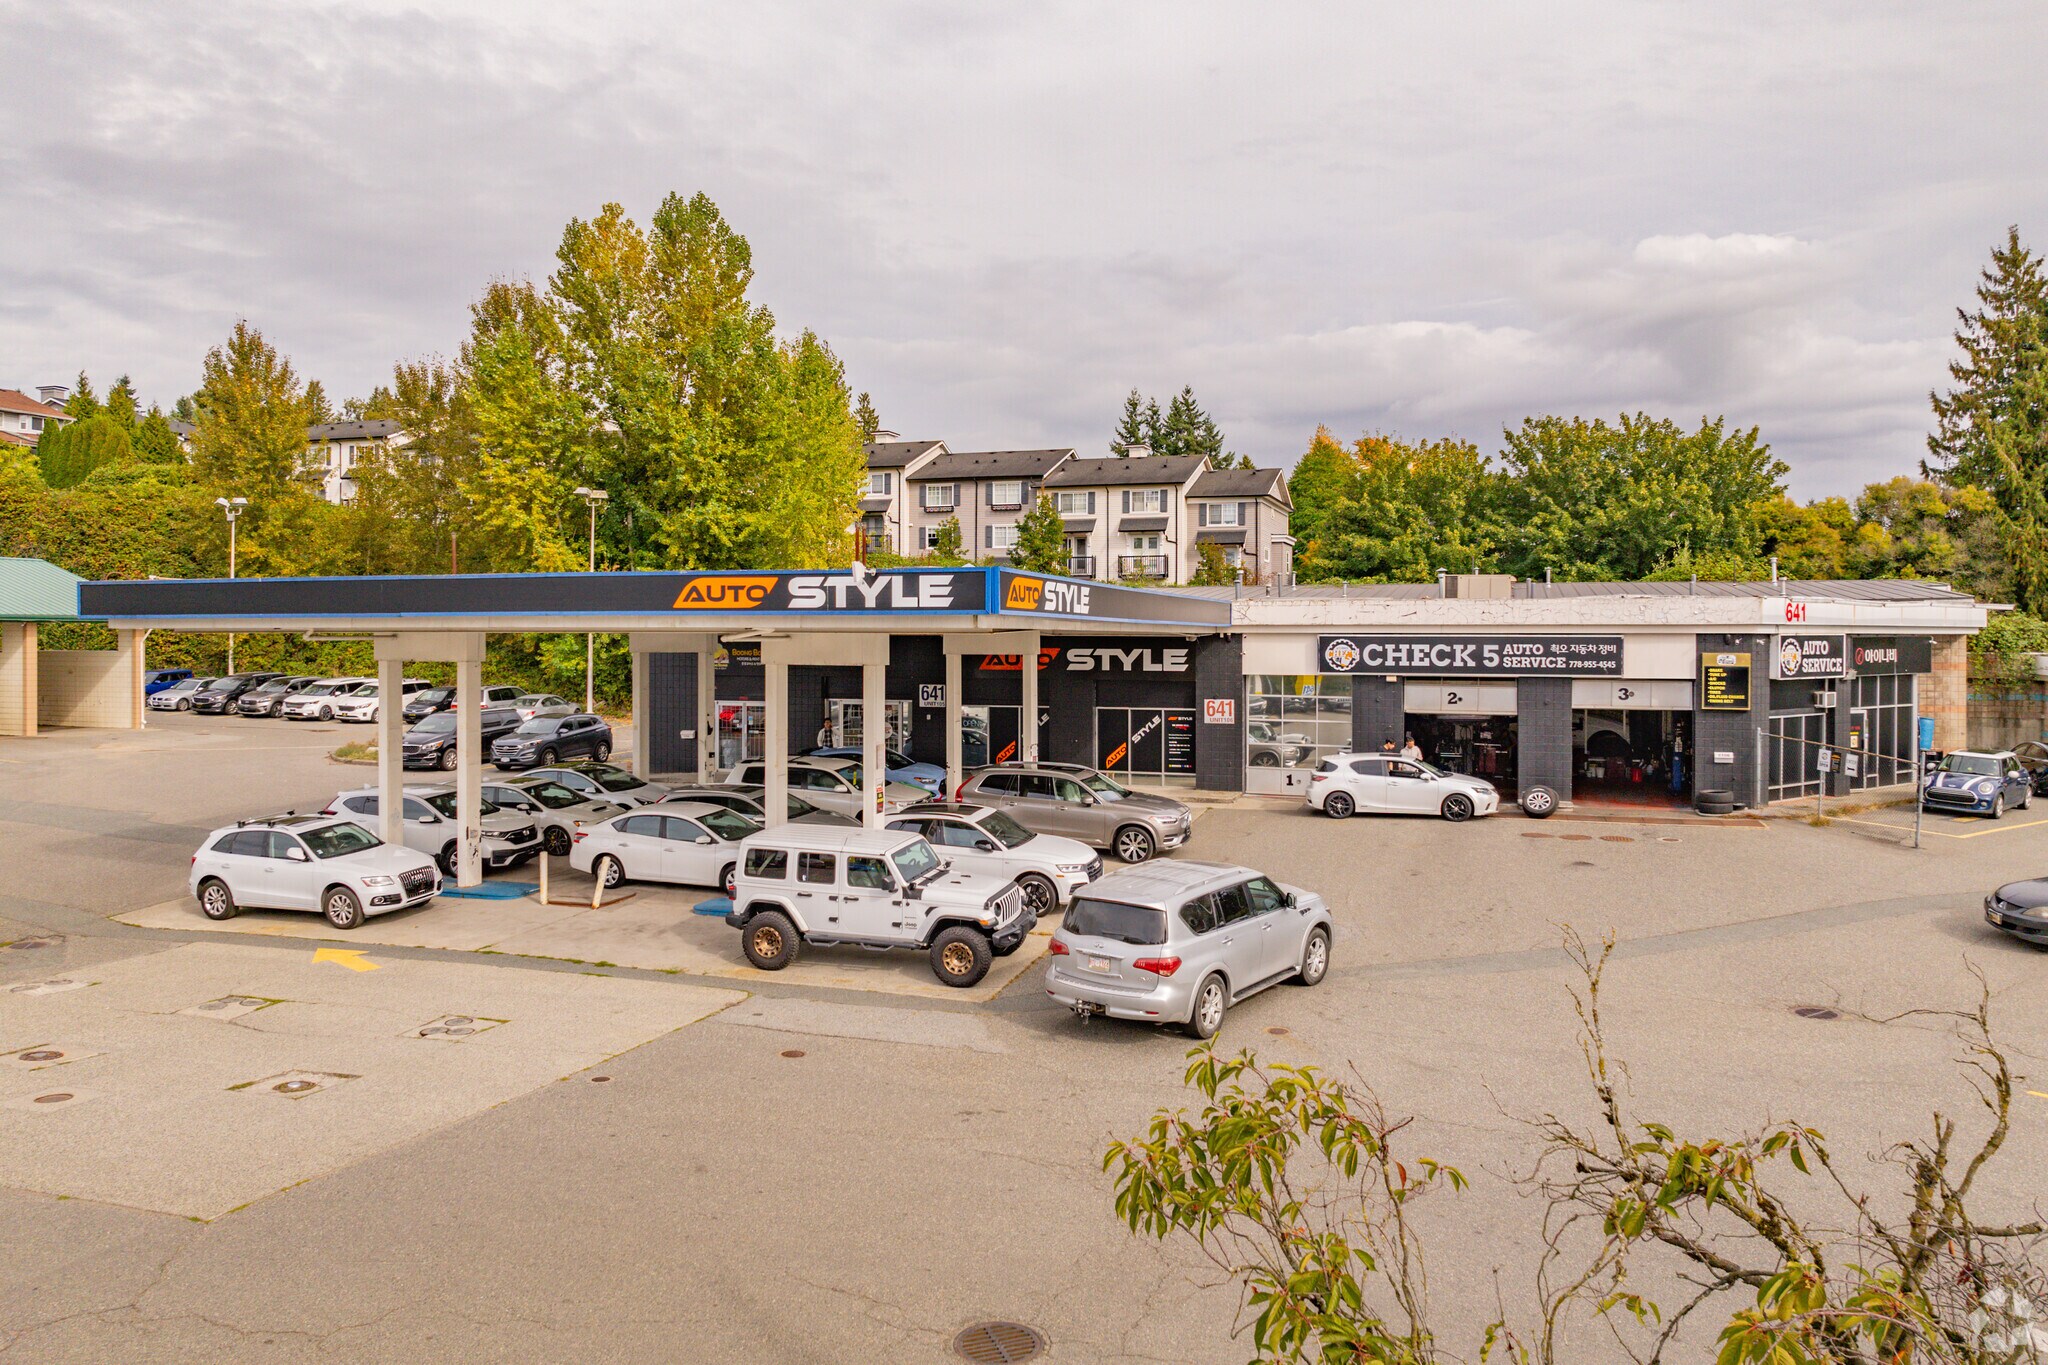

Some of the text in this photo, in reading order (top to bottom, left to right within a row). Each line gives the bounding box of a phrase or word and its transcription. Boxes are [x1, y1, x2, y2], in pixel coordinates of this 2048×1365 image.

[683, 575, 955, 608] AUTO STYLE
[1010, 581, 1091, 614] AUTO STYLE
[1786, 603, 1806, 622] 641
[1503, 644, 1544, 655] AUTO
[1570, 644, 1597, 655] 자동차
[1598, 644, 1617, 655] 정비
[1802, 640, 1829, 655] AUTO
[986, 648, 1189, 671] AUO STYLE
[1363, 644, 1500, 668] CHECK 5
[1503, 657, 1566, 668] SERVICE
[1802, 658, 1843, 673] SERVICE
[921, 685, 944, 701] 641
[1447, 692, 1458, 704] 2
[1618, 687, 1629, 700] 3
[1206, 700, 1233, 717] 641
[1107, 714, 1161, 765] AUTO STYLE
[1286, 774, 1294, 786] 1
